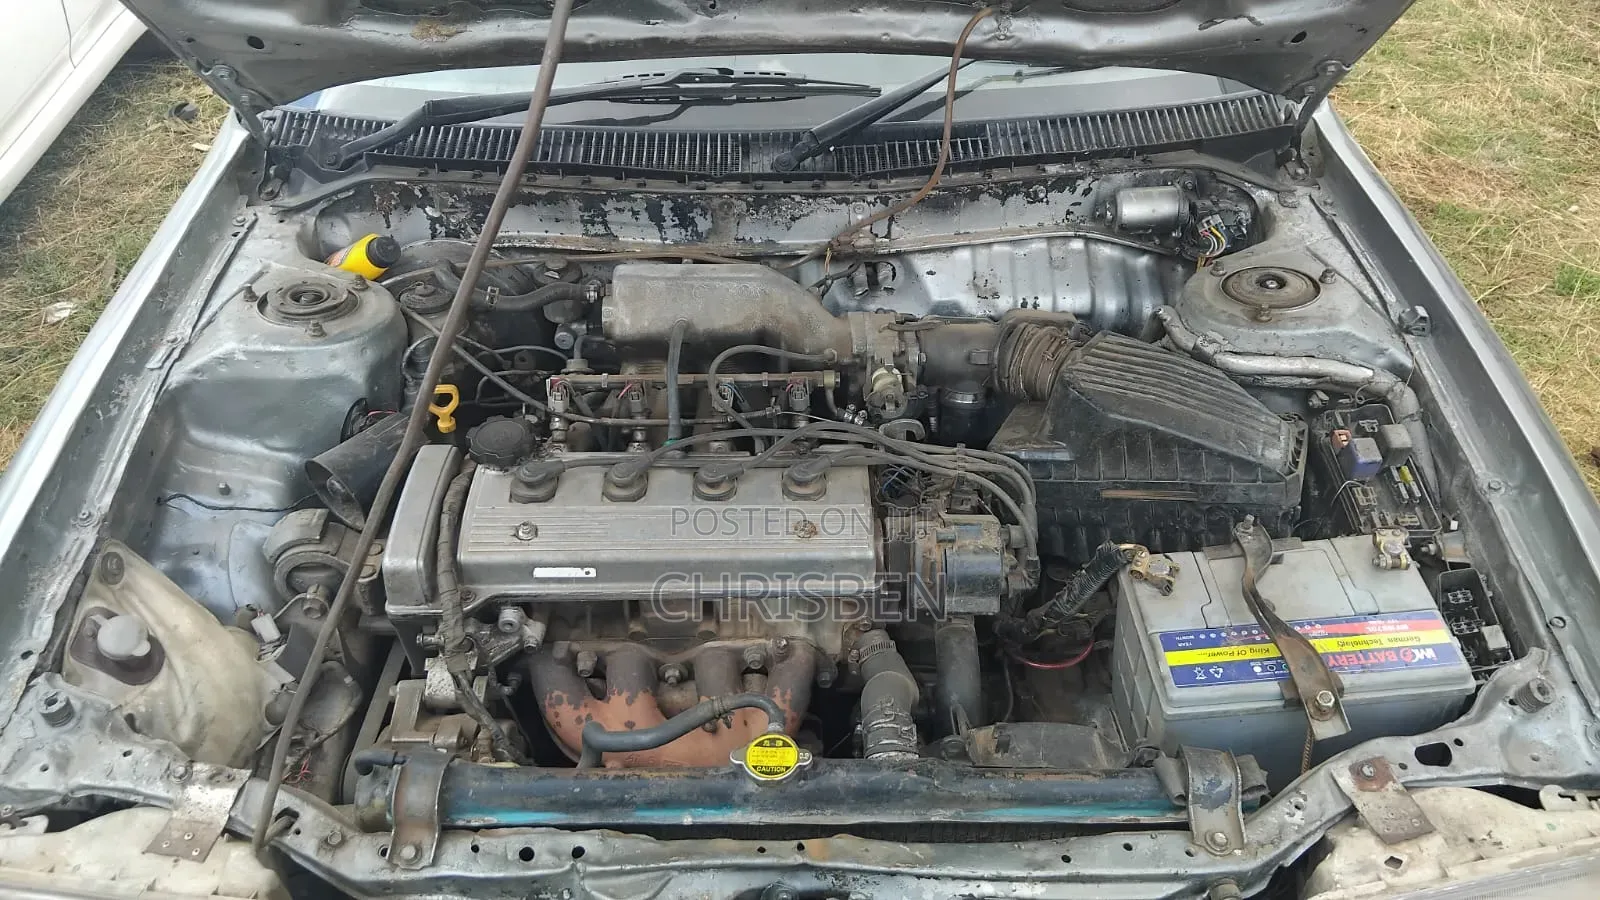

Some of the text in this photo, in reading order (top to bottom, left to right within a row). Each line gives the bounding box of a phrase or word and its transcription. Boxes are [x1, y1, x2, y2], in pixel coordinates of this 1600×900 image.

[1387, 636, 1421, 644] German
[1250, 647, 1270, 655] King
[1327, 650, 1399, 667] BATTERY
